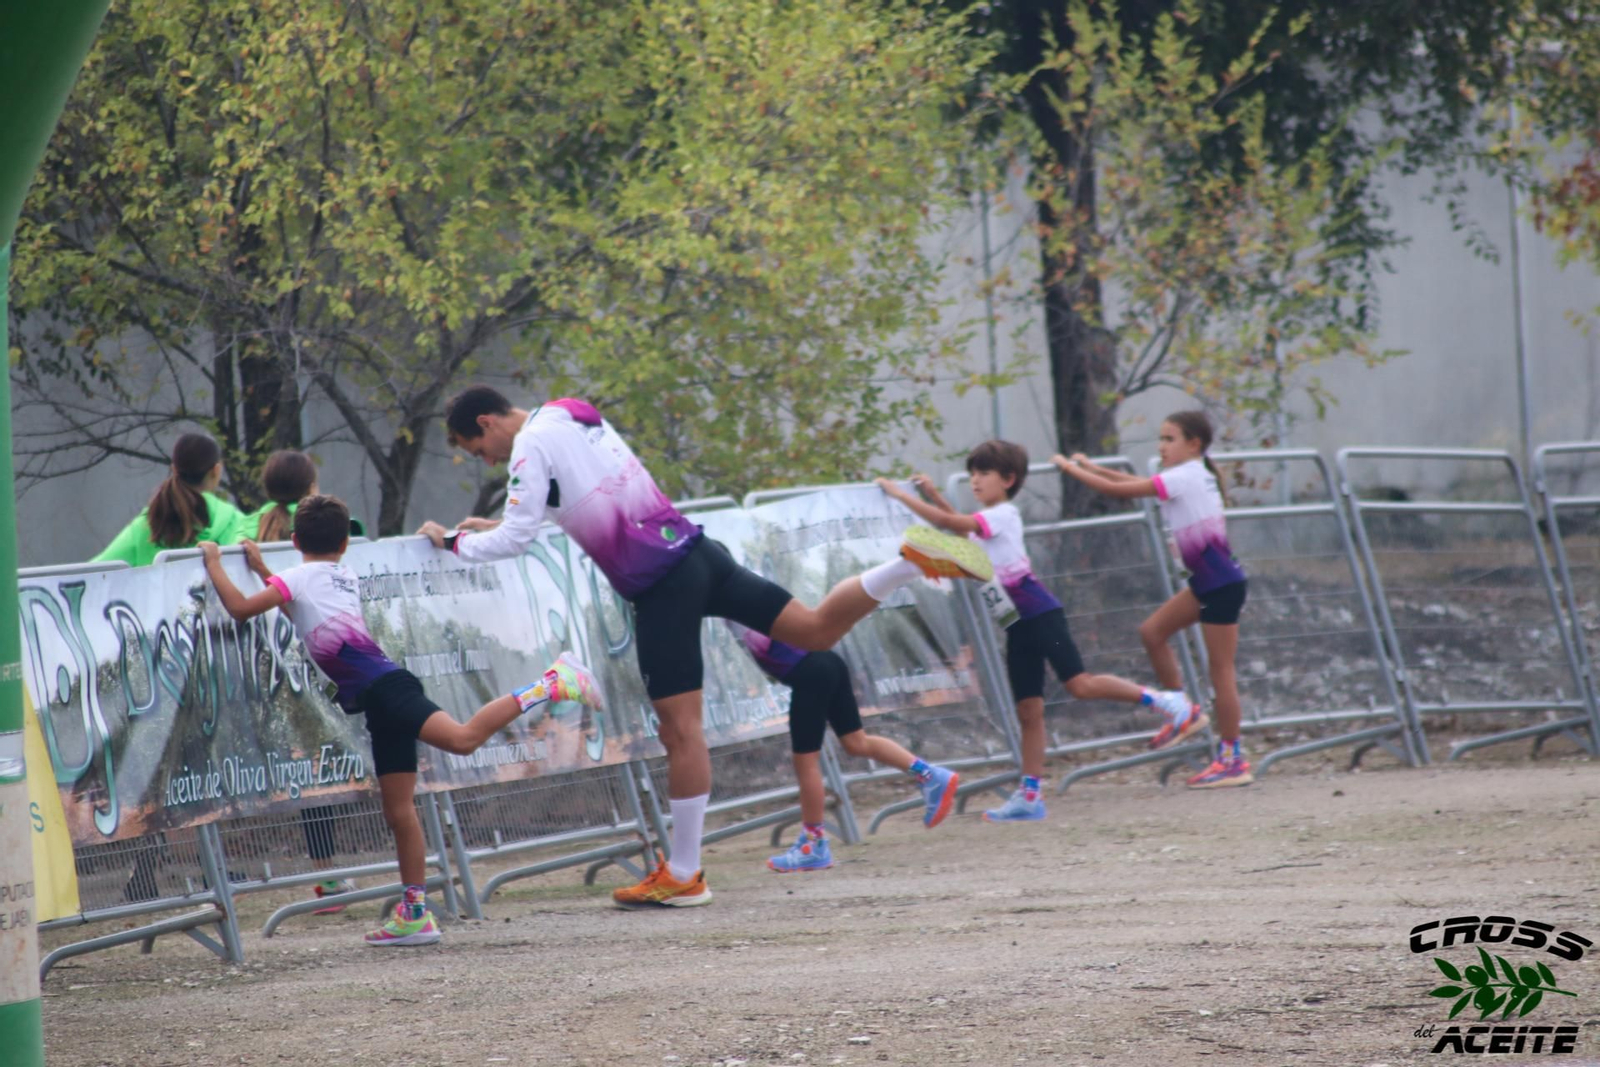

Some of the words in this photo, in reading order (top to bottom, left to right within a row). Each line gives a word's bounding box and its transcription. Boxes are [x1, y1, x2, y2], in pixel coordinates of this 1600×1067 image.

[205, 759, 222, 799] de
[222, 756, 266, 796] Oliva
[266, 752, 314, 799] Virgen
[318, 744, 365, 785] Extra
